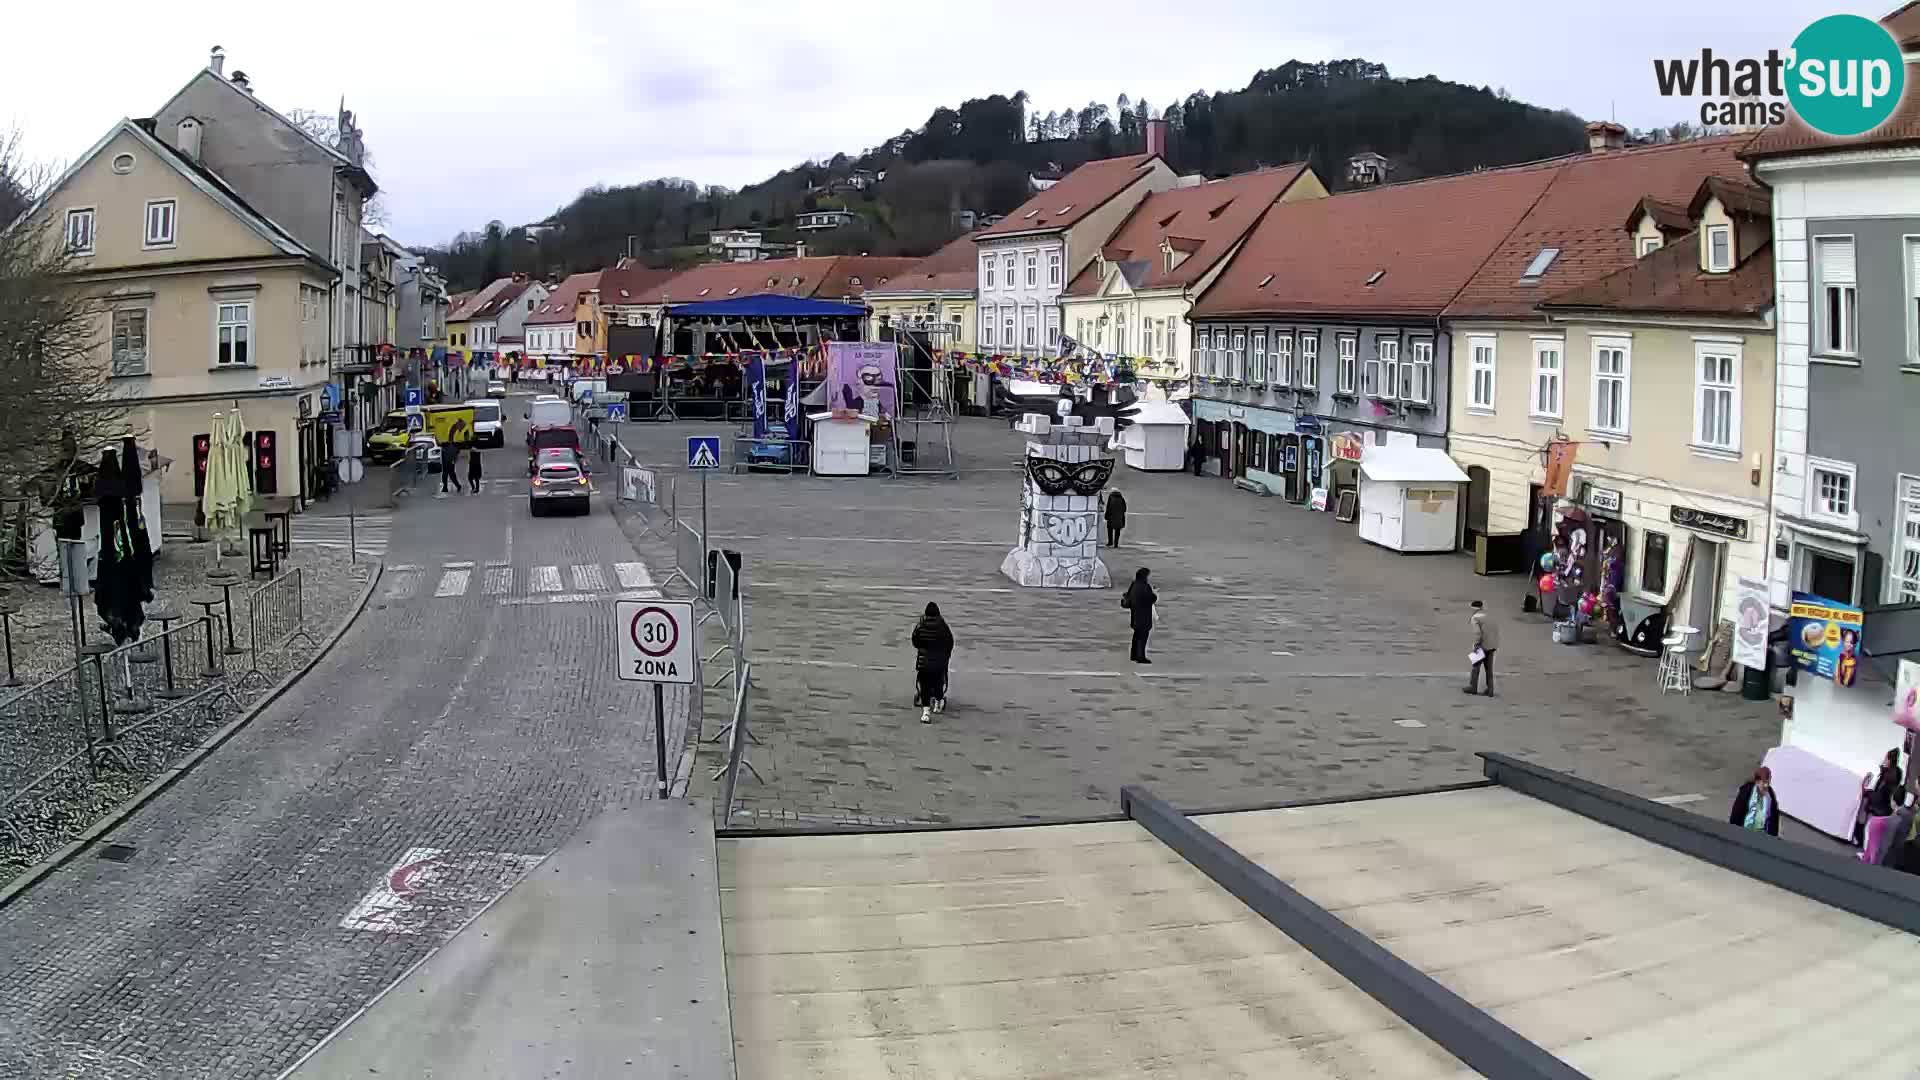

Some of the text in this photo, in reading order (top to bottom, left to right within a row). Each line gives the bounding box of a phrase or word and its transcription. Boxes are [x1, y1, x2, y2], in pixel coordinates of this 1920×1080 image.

[1048, 516, 1087, 545] 200
[643, 622, 667, 643] 30
[634, 660, 678, 677] ZONA
